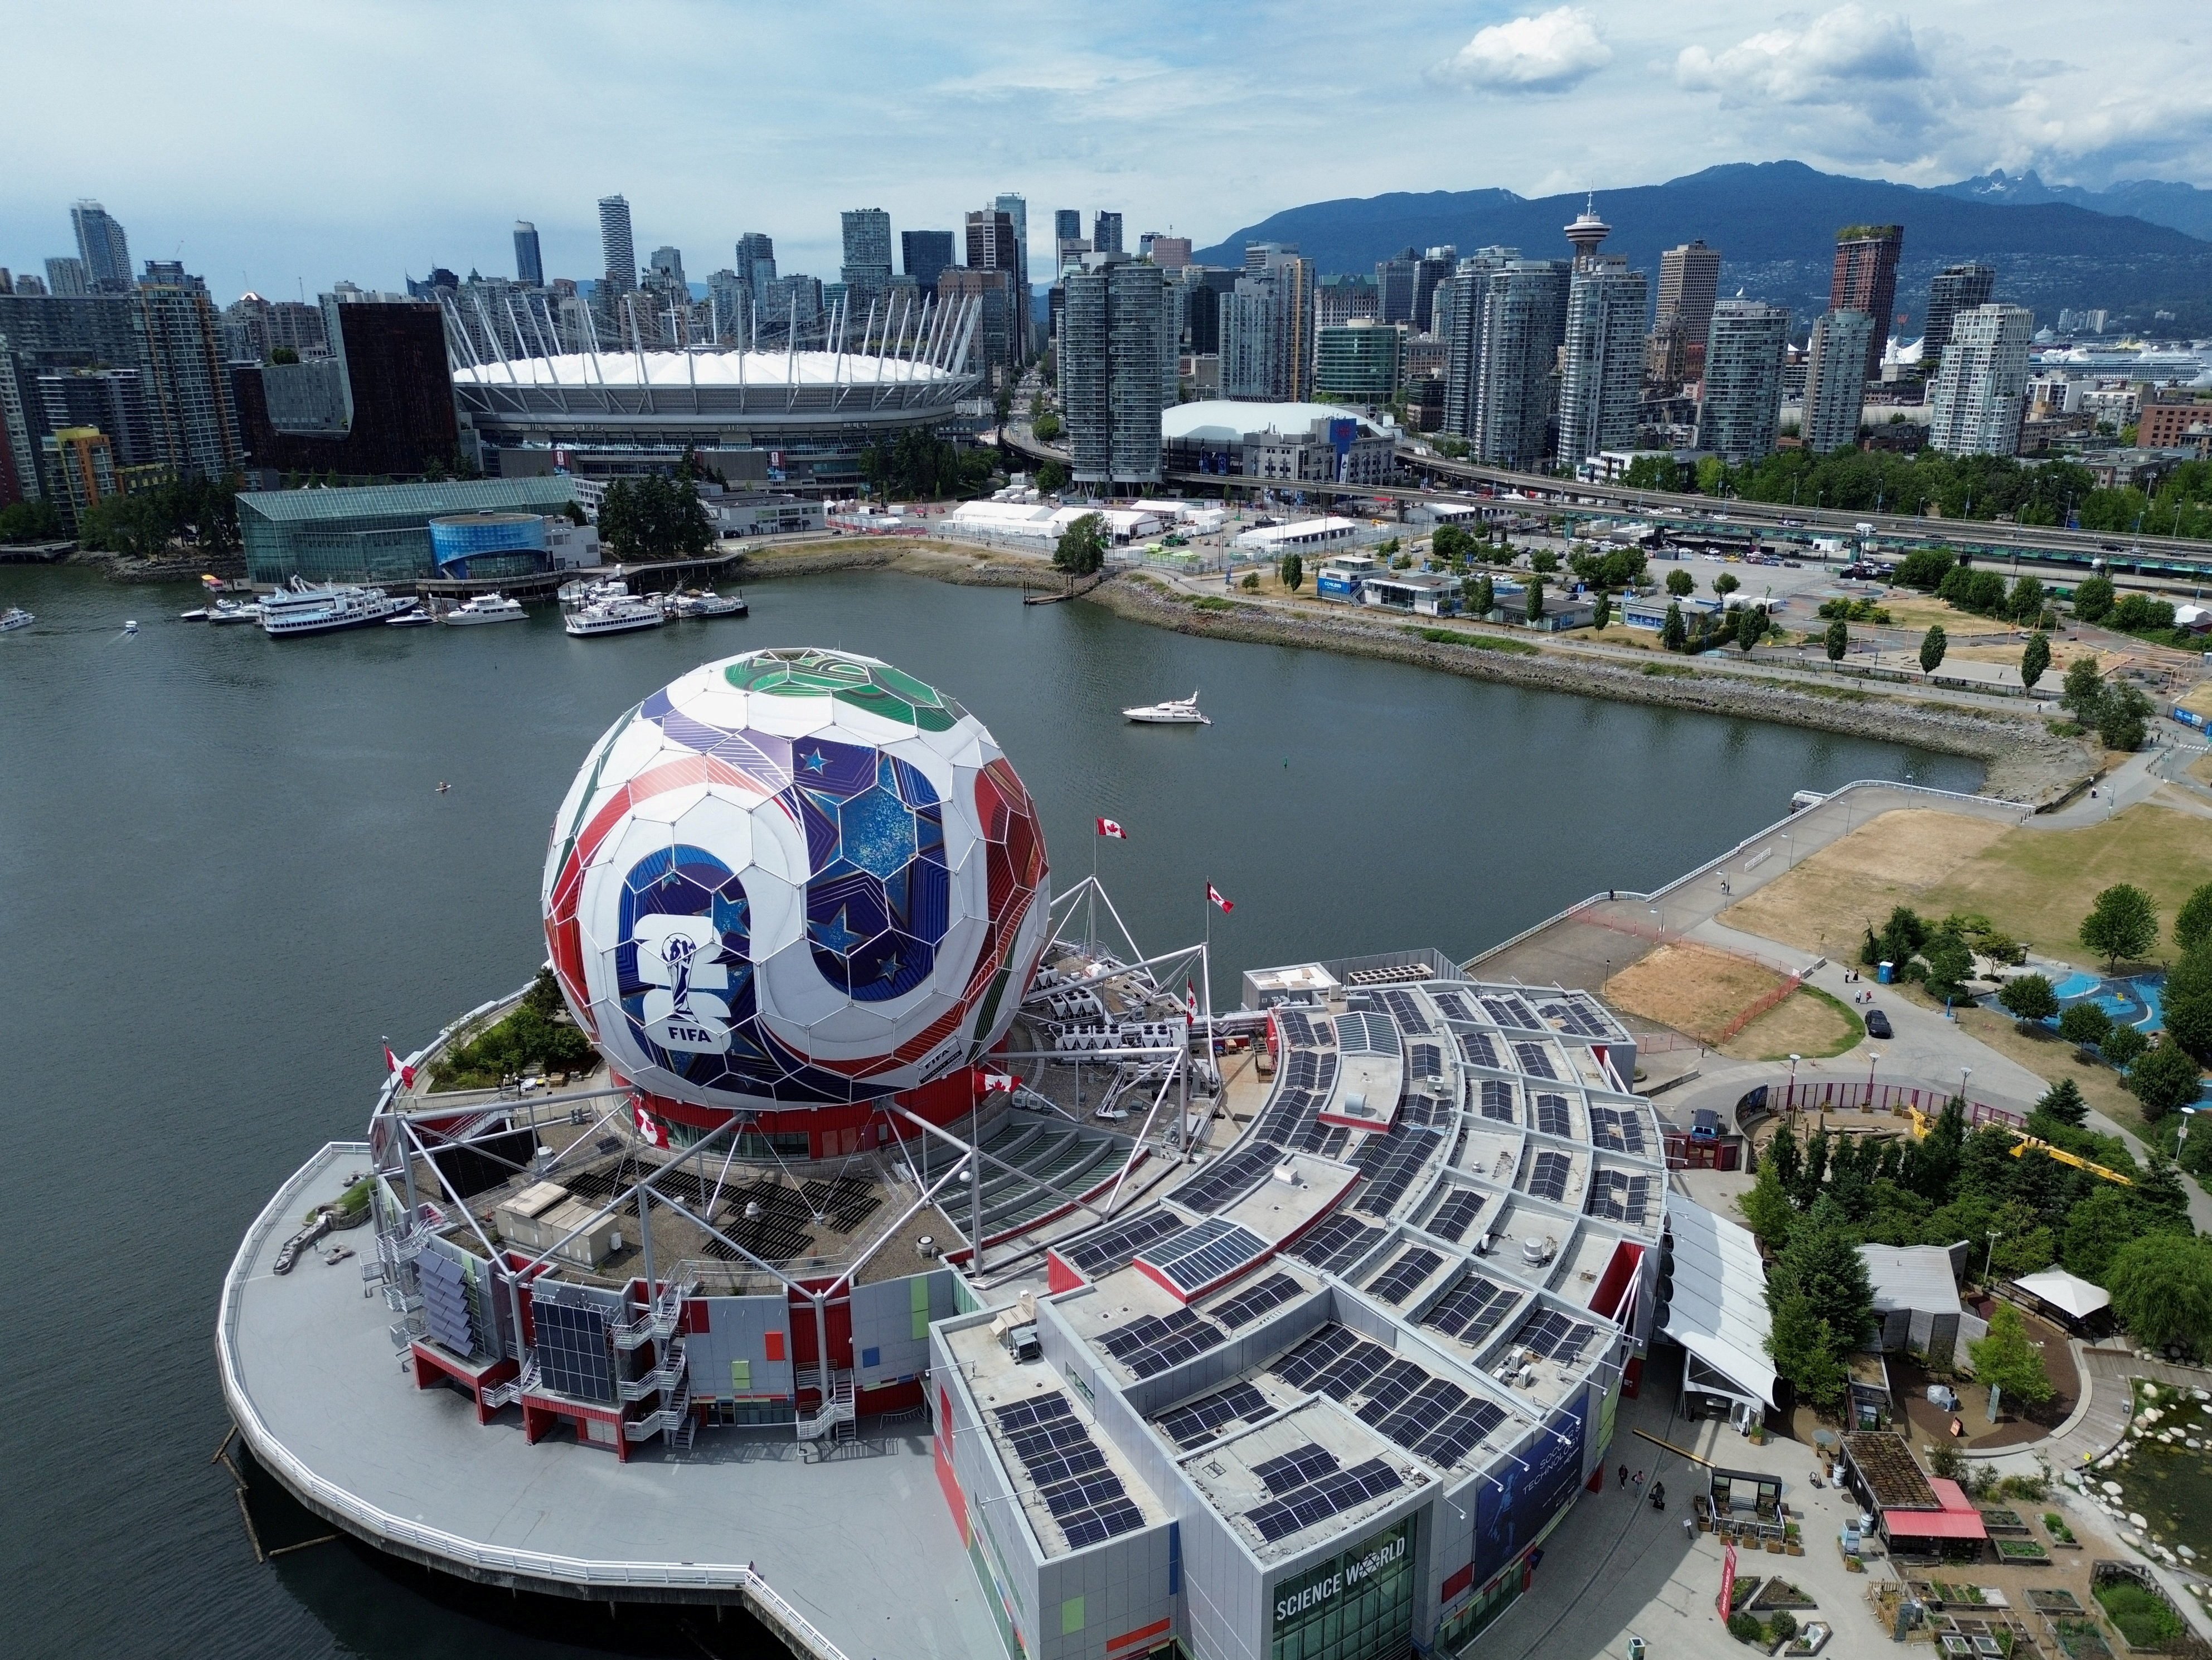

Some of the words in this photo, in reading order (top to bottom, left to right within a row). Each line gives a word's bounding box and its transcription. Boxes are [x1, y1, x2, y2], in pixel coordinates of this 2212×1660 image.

[667, 1026, 712, 1043] FIFA
[923, 1062, 948, 1082] QUALITY
[948, 1052, 959, 1063] PRO
[925, 1048, 949, 1069] FIFA
[1522, 1434, 1580, 1495] TECHNOLOGY
[1277, 1572, 1342, 1621] SCIENCE
[1346, 1537, 1405, 1586] WORLD
